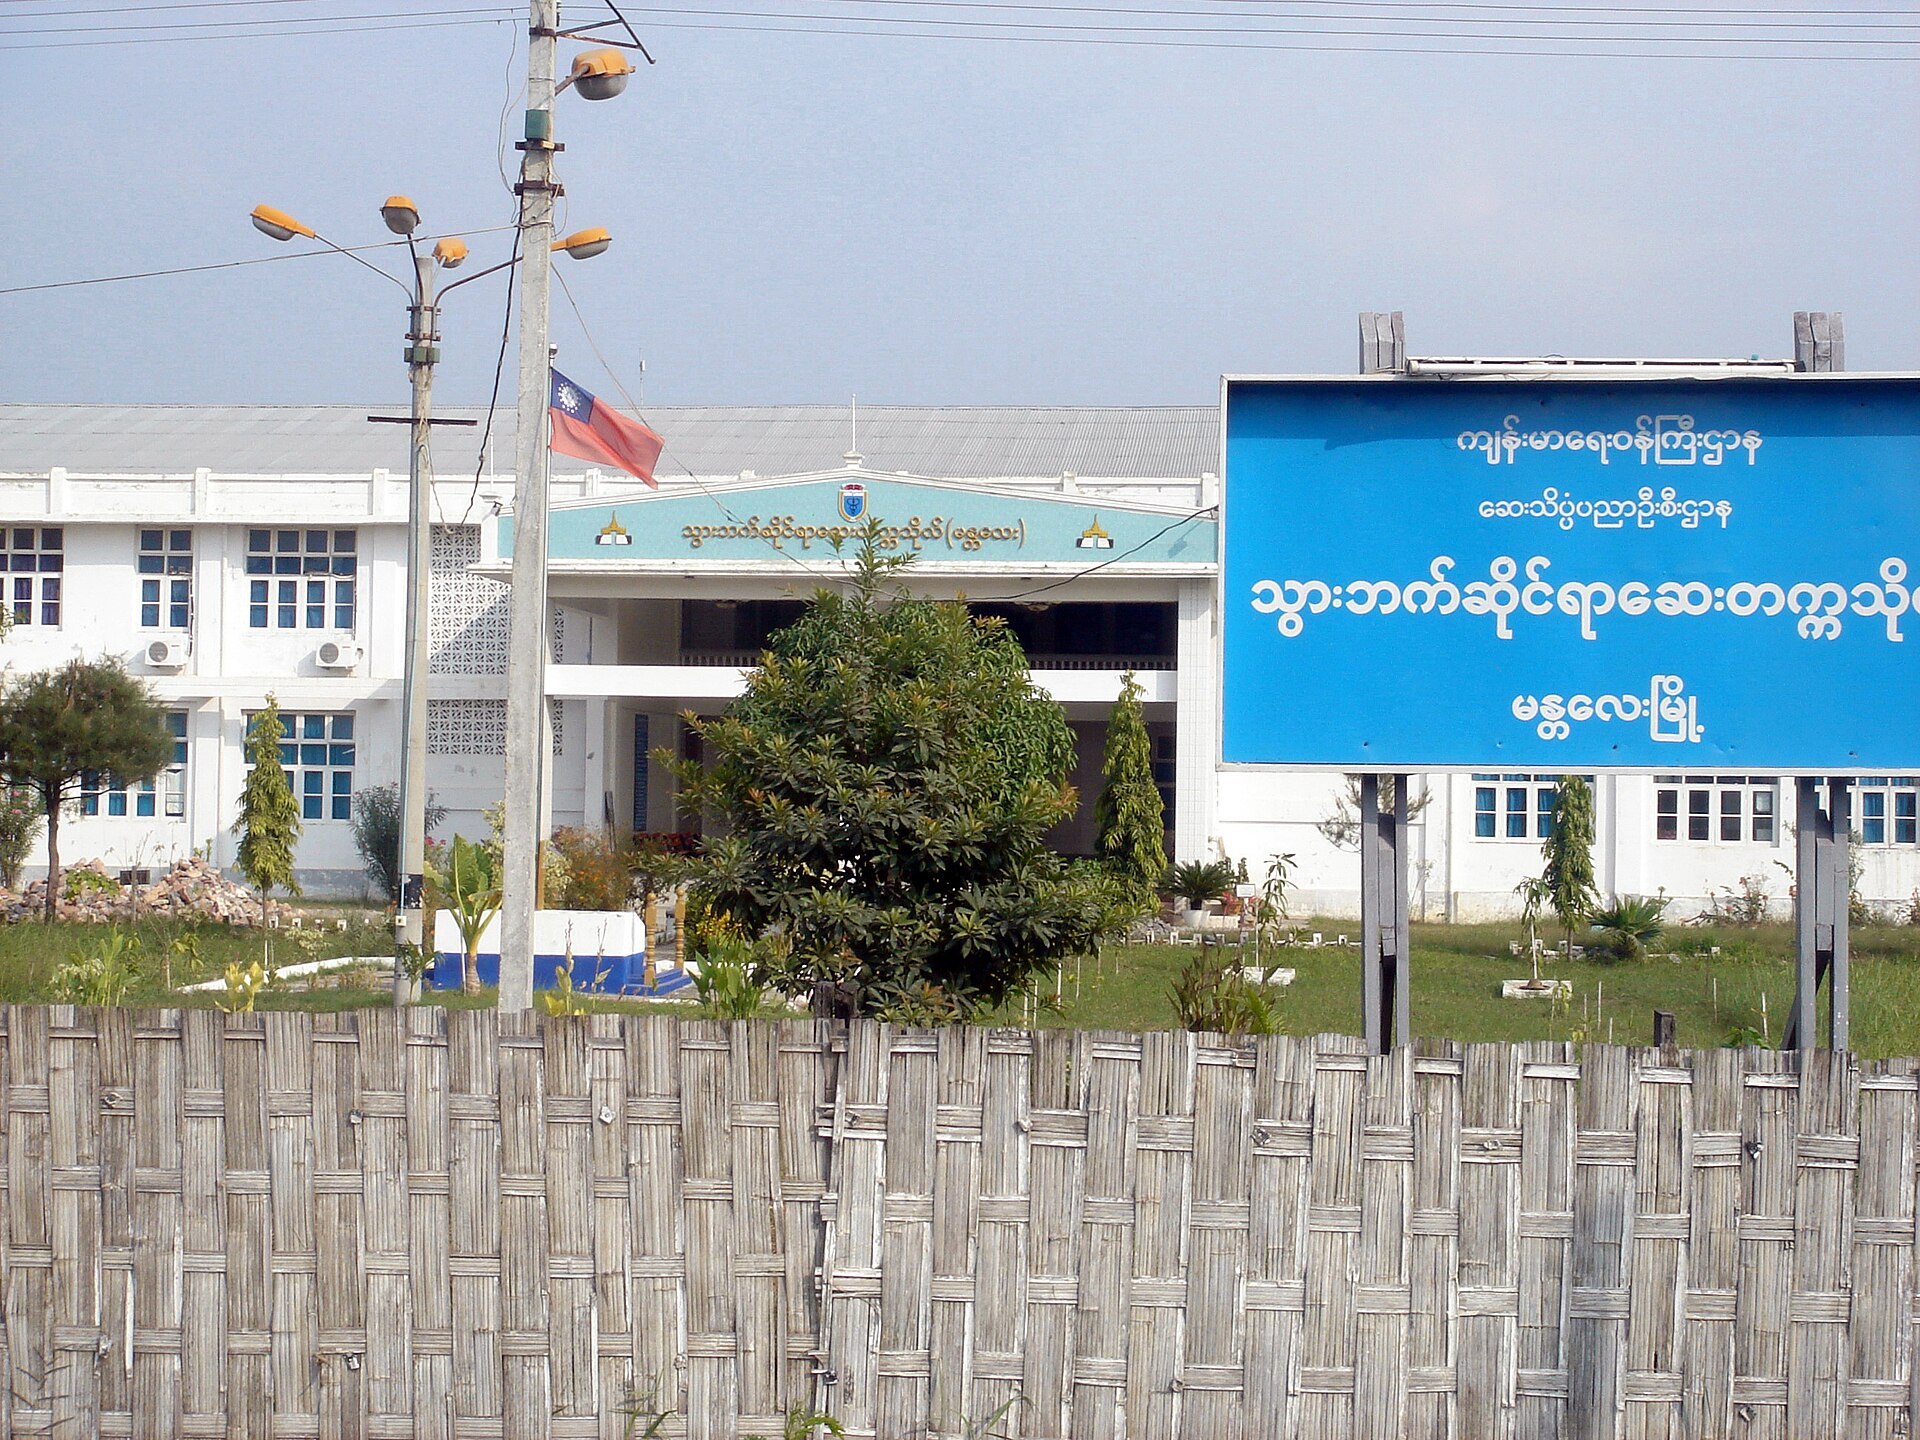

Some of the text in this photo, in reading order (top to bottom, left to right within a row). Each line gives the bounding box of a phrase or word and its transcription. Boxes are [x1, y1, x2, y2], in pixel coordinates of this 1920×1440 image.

[1250, 555, 1920, 642] သွားဘက်ဆိုင်ရာဆေးတက္ကသို
